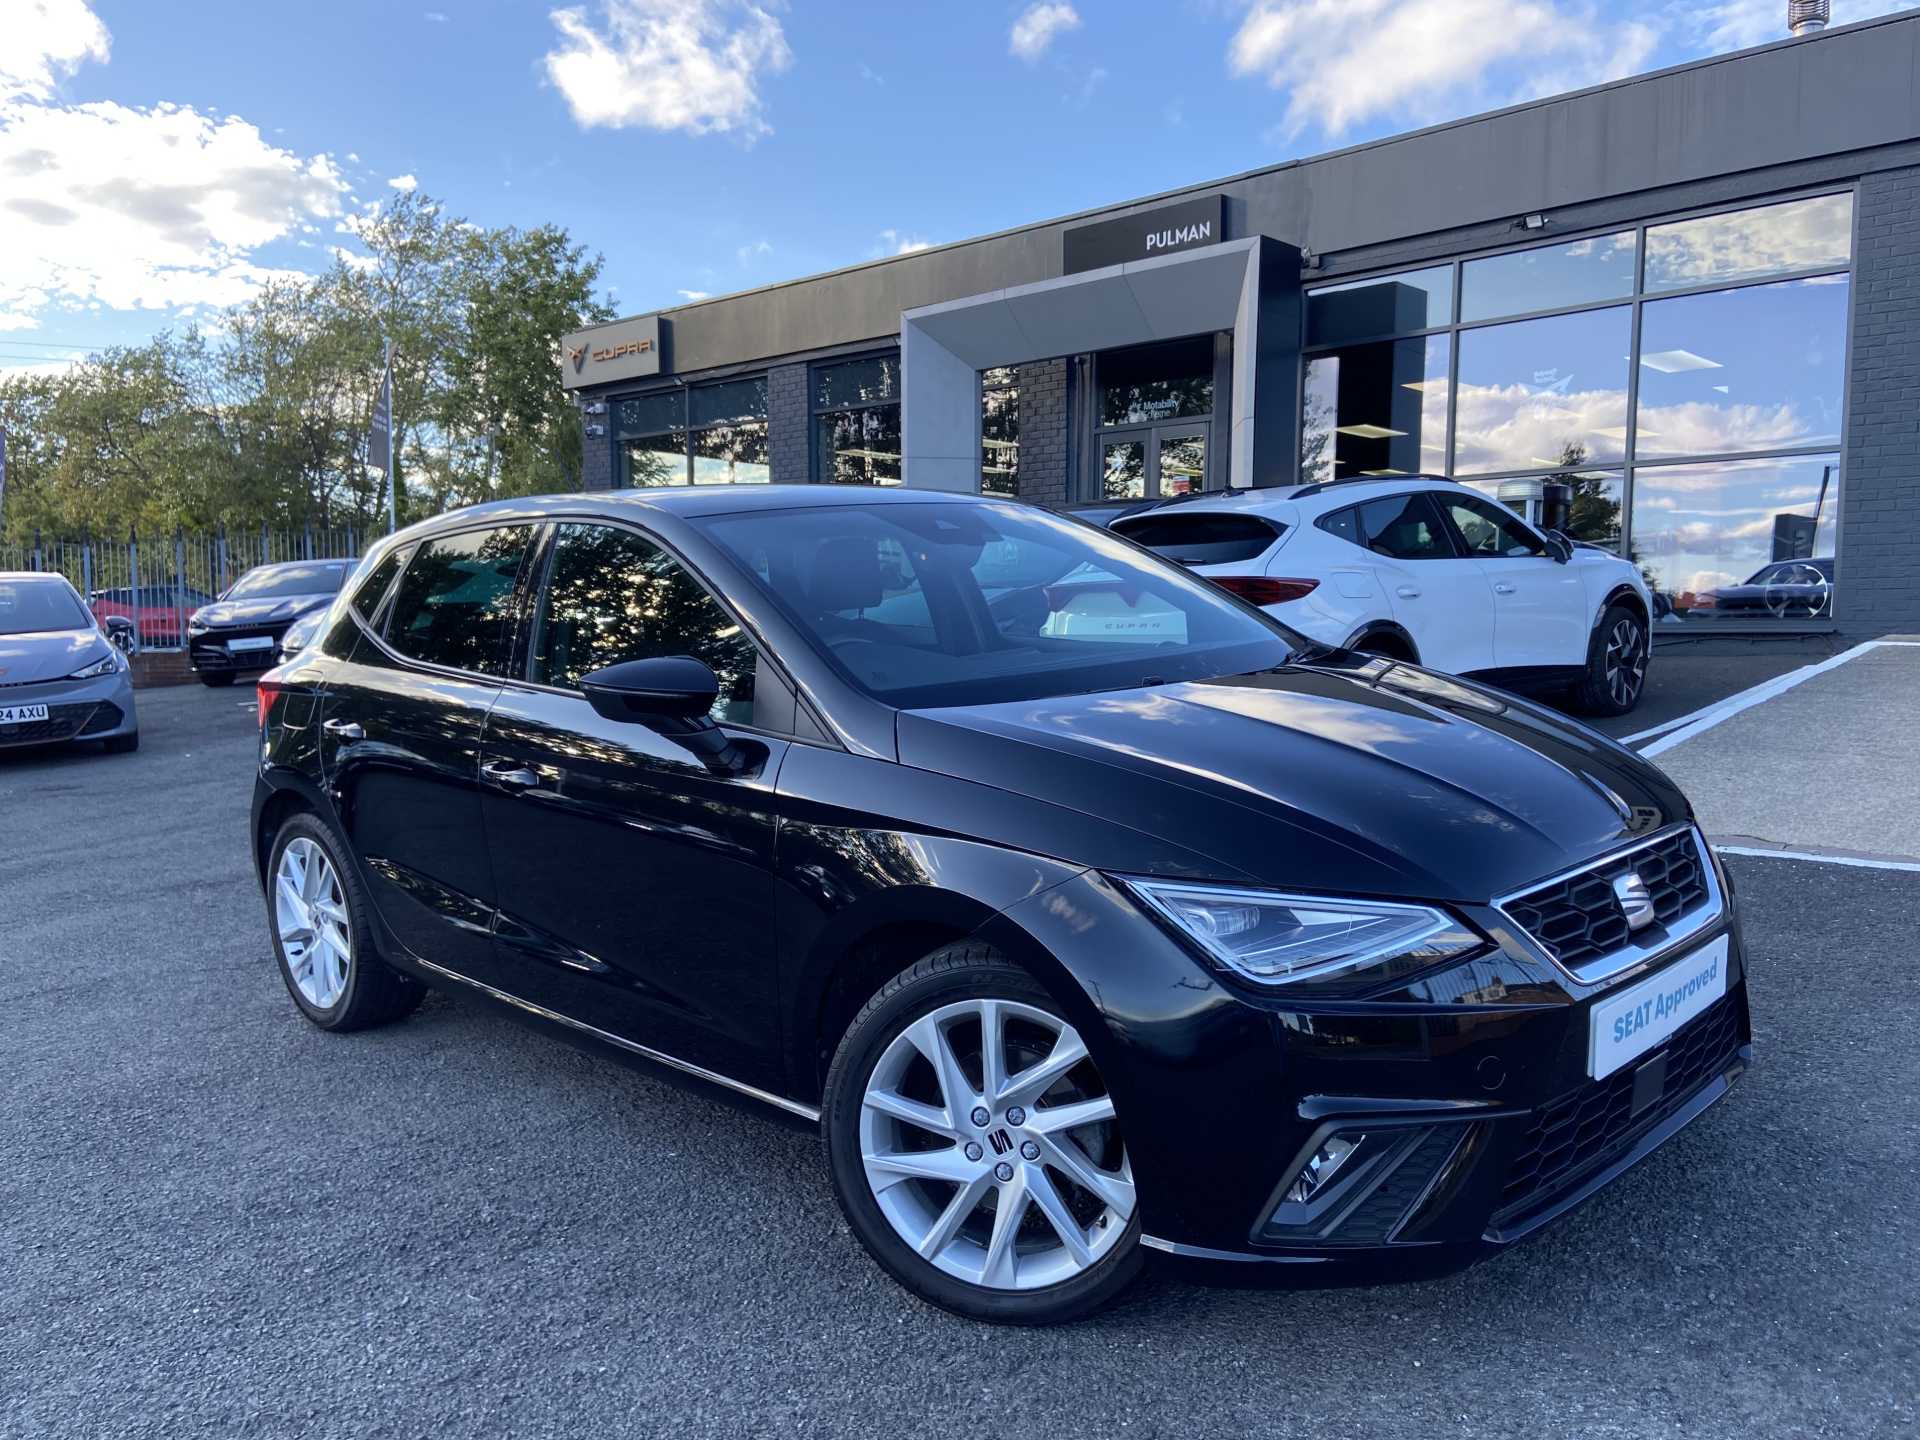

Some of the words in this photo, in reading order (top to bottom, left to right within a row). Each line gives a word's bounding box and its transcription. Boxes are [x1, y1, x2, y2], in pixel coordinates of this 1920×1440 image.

[1146, 220, 1210, 250] PULMAN
[592, 337, 654, 361] CUPRA
[19, 706, 45, 719] AXU
[1613, 999, 1653, 1044] SEAT
[1654, 955, 1718, 1021] Approved
